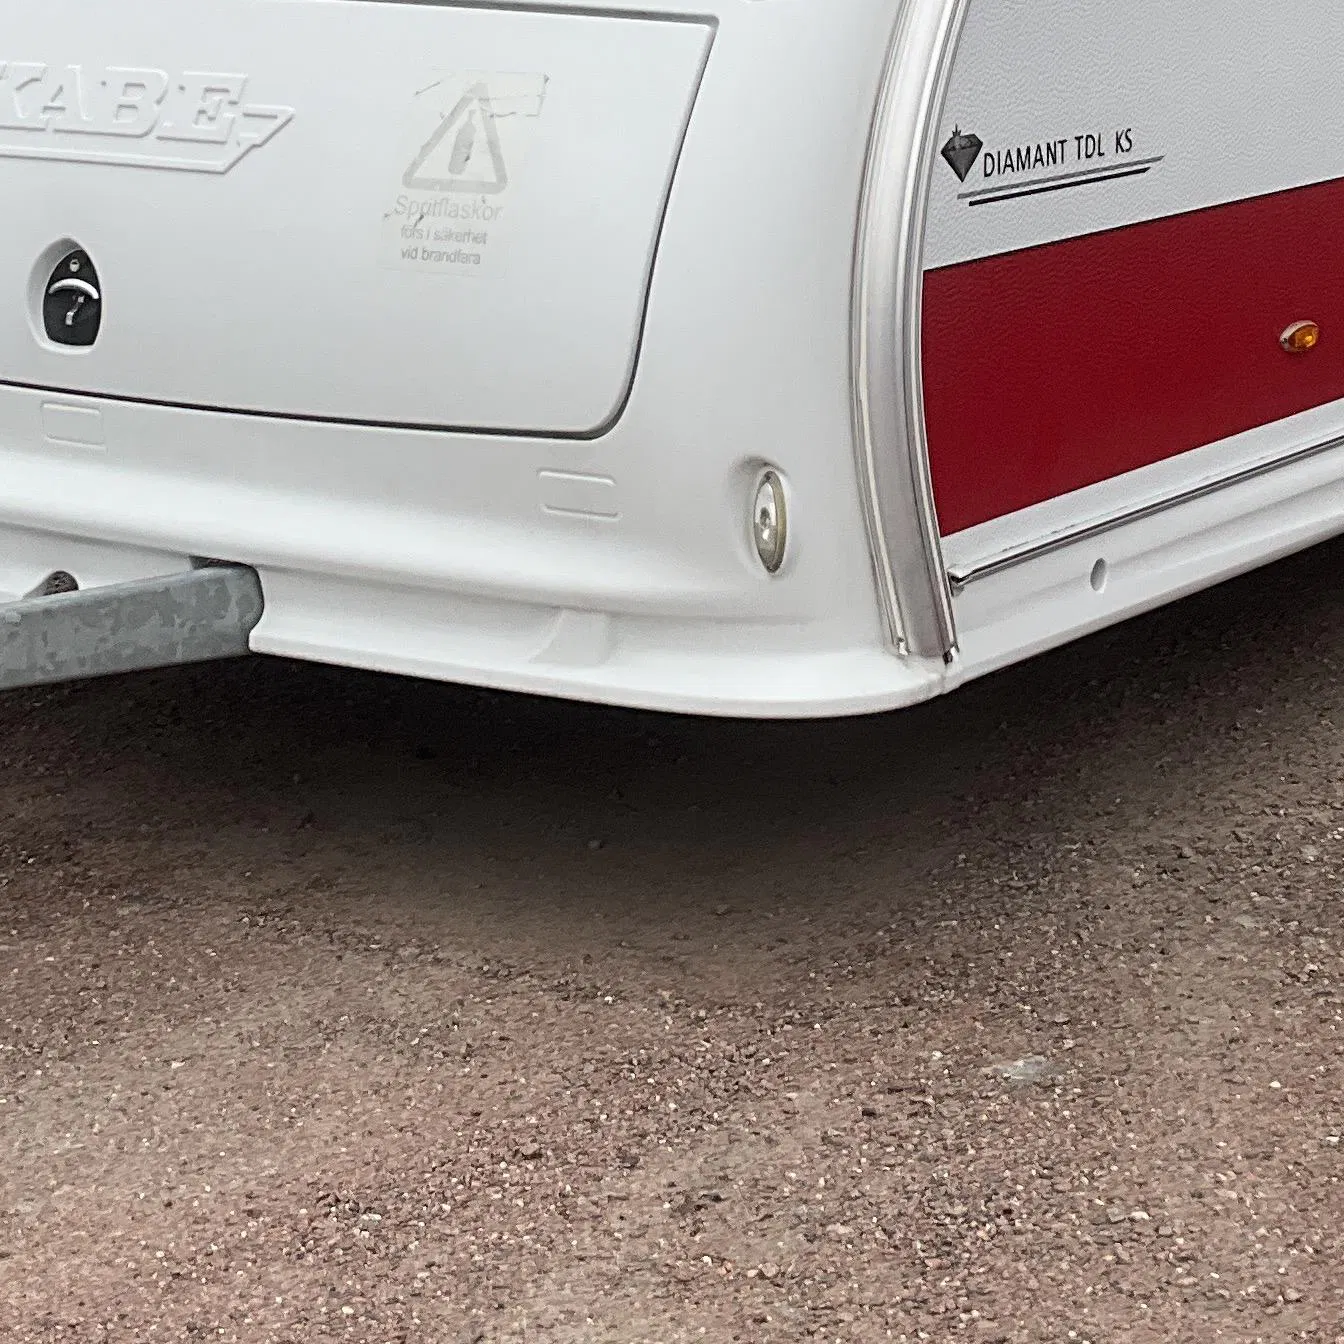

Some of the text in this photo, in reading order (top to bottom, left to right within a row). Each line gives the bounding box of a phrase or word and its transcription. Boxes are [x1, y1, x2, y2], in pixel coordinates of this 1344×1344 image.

[983, 128, 1133, 177] DIAMANT TDL KS
[400, 247, 481, 265] vid brandfara
